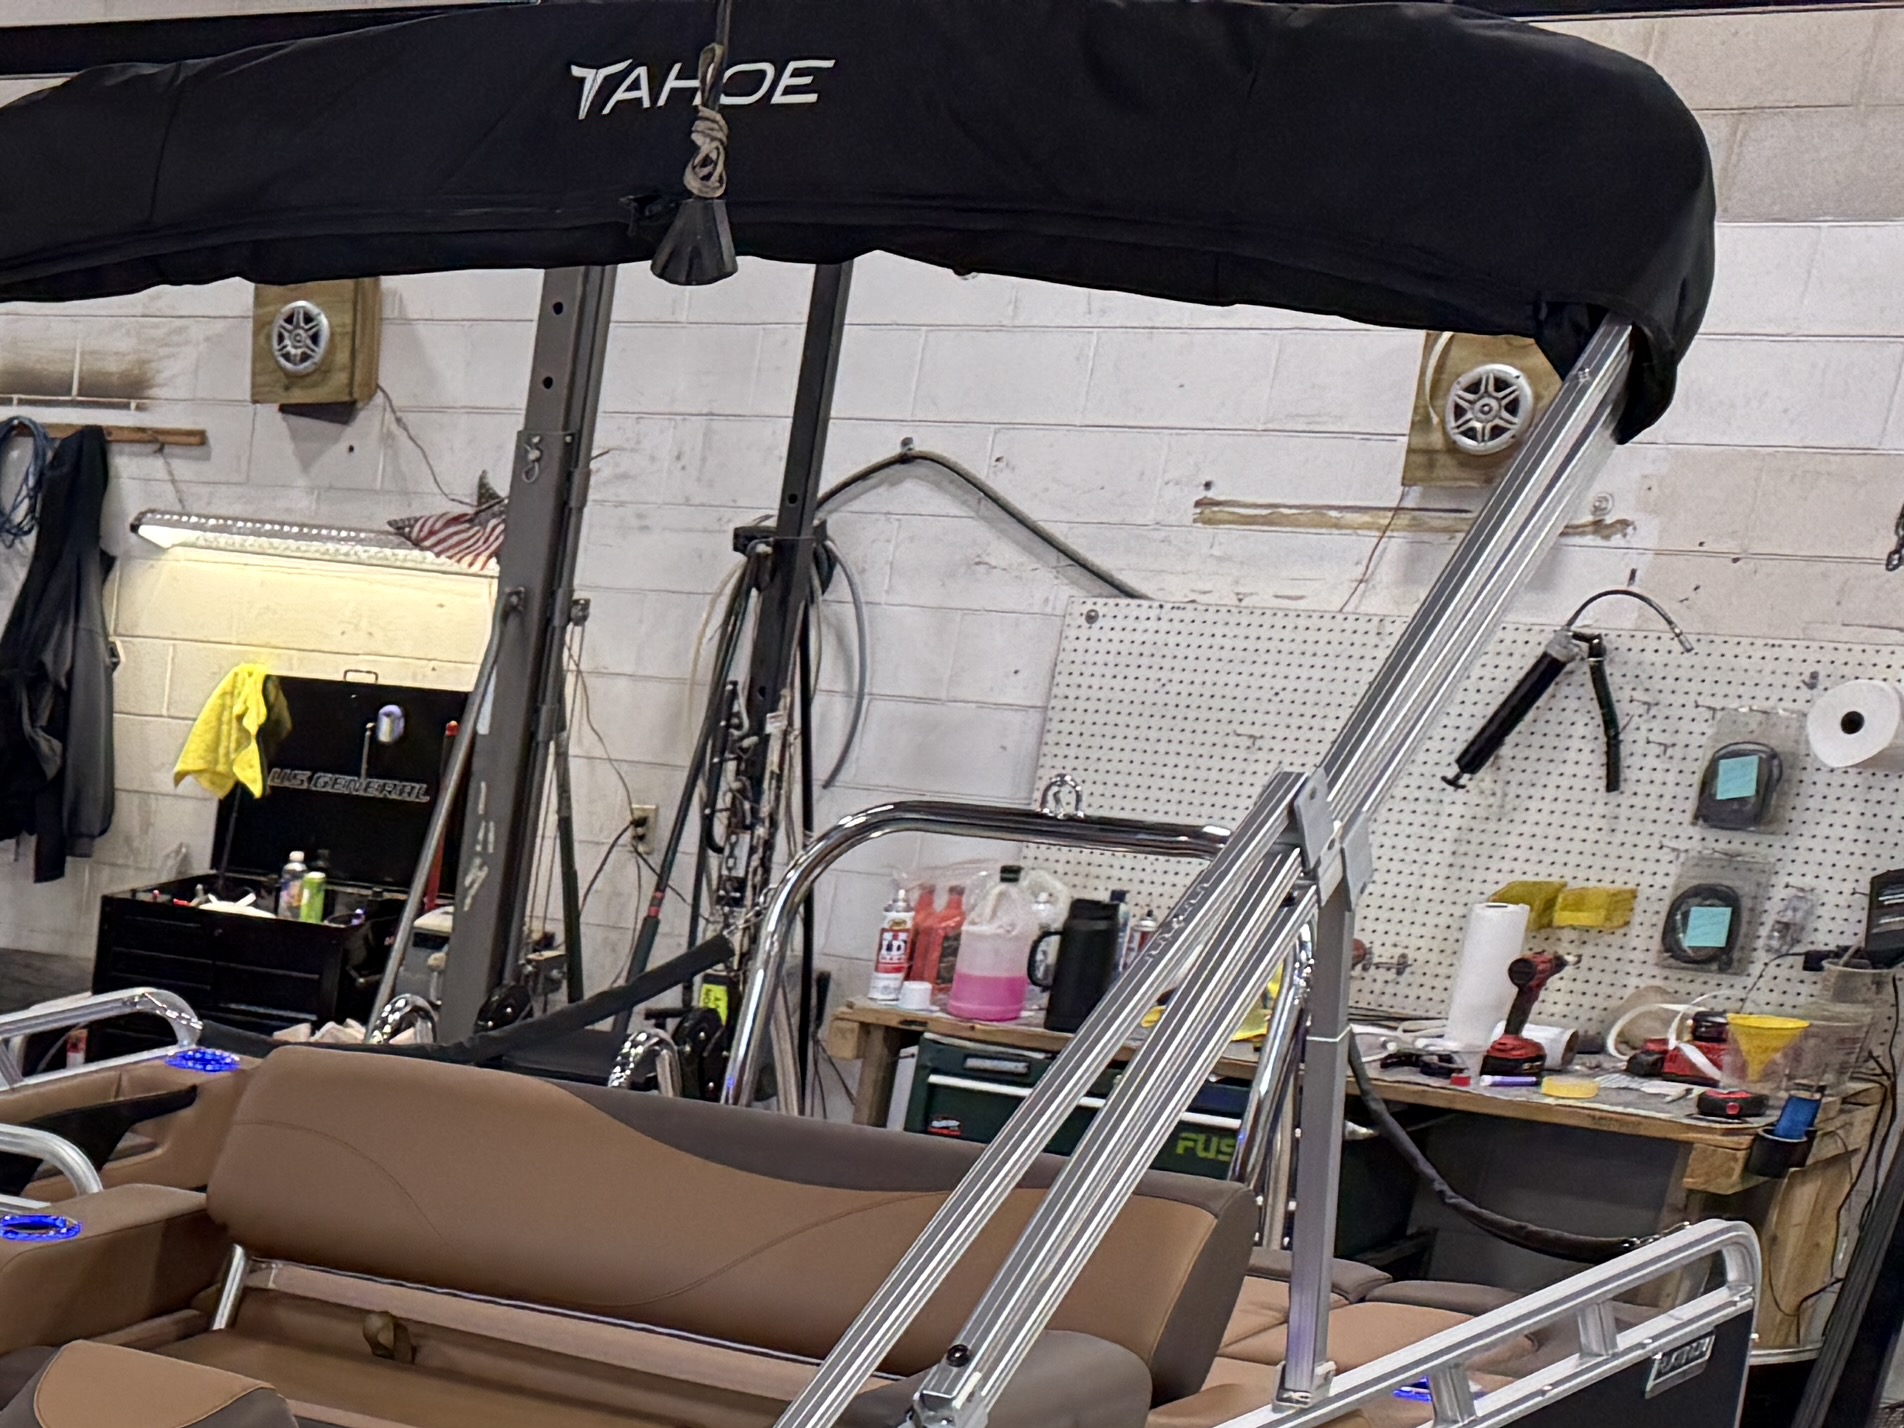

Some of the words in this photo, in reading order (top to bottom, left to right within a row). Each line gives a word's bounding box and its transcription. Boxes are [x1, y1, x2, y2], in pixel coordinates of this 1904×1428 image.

[571, 58, 836, 120] TAHOE
[267, 768, 312, 789] US
[311, 772, 431, 802] GENERAL
